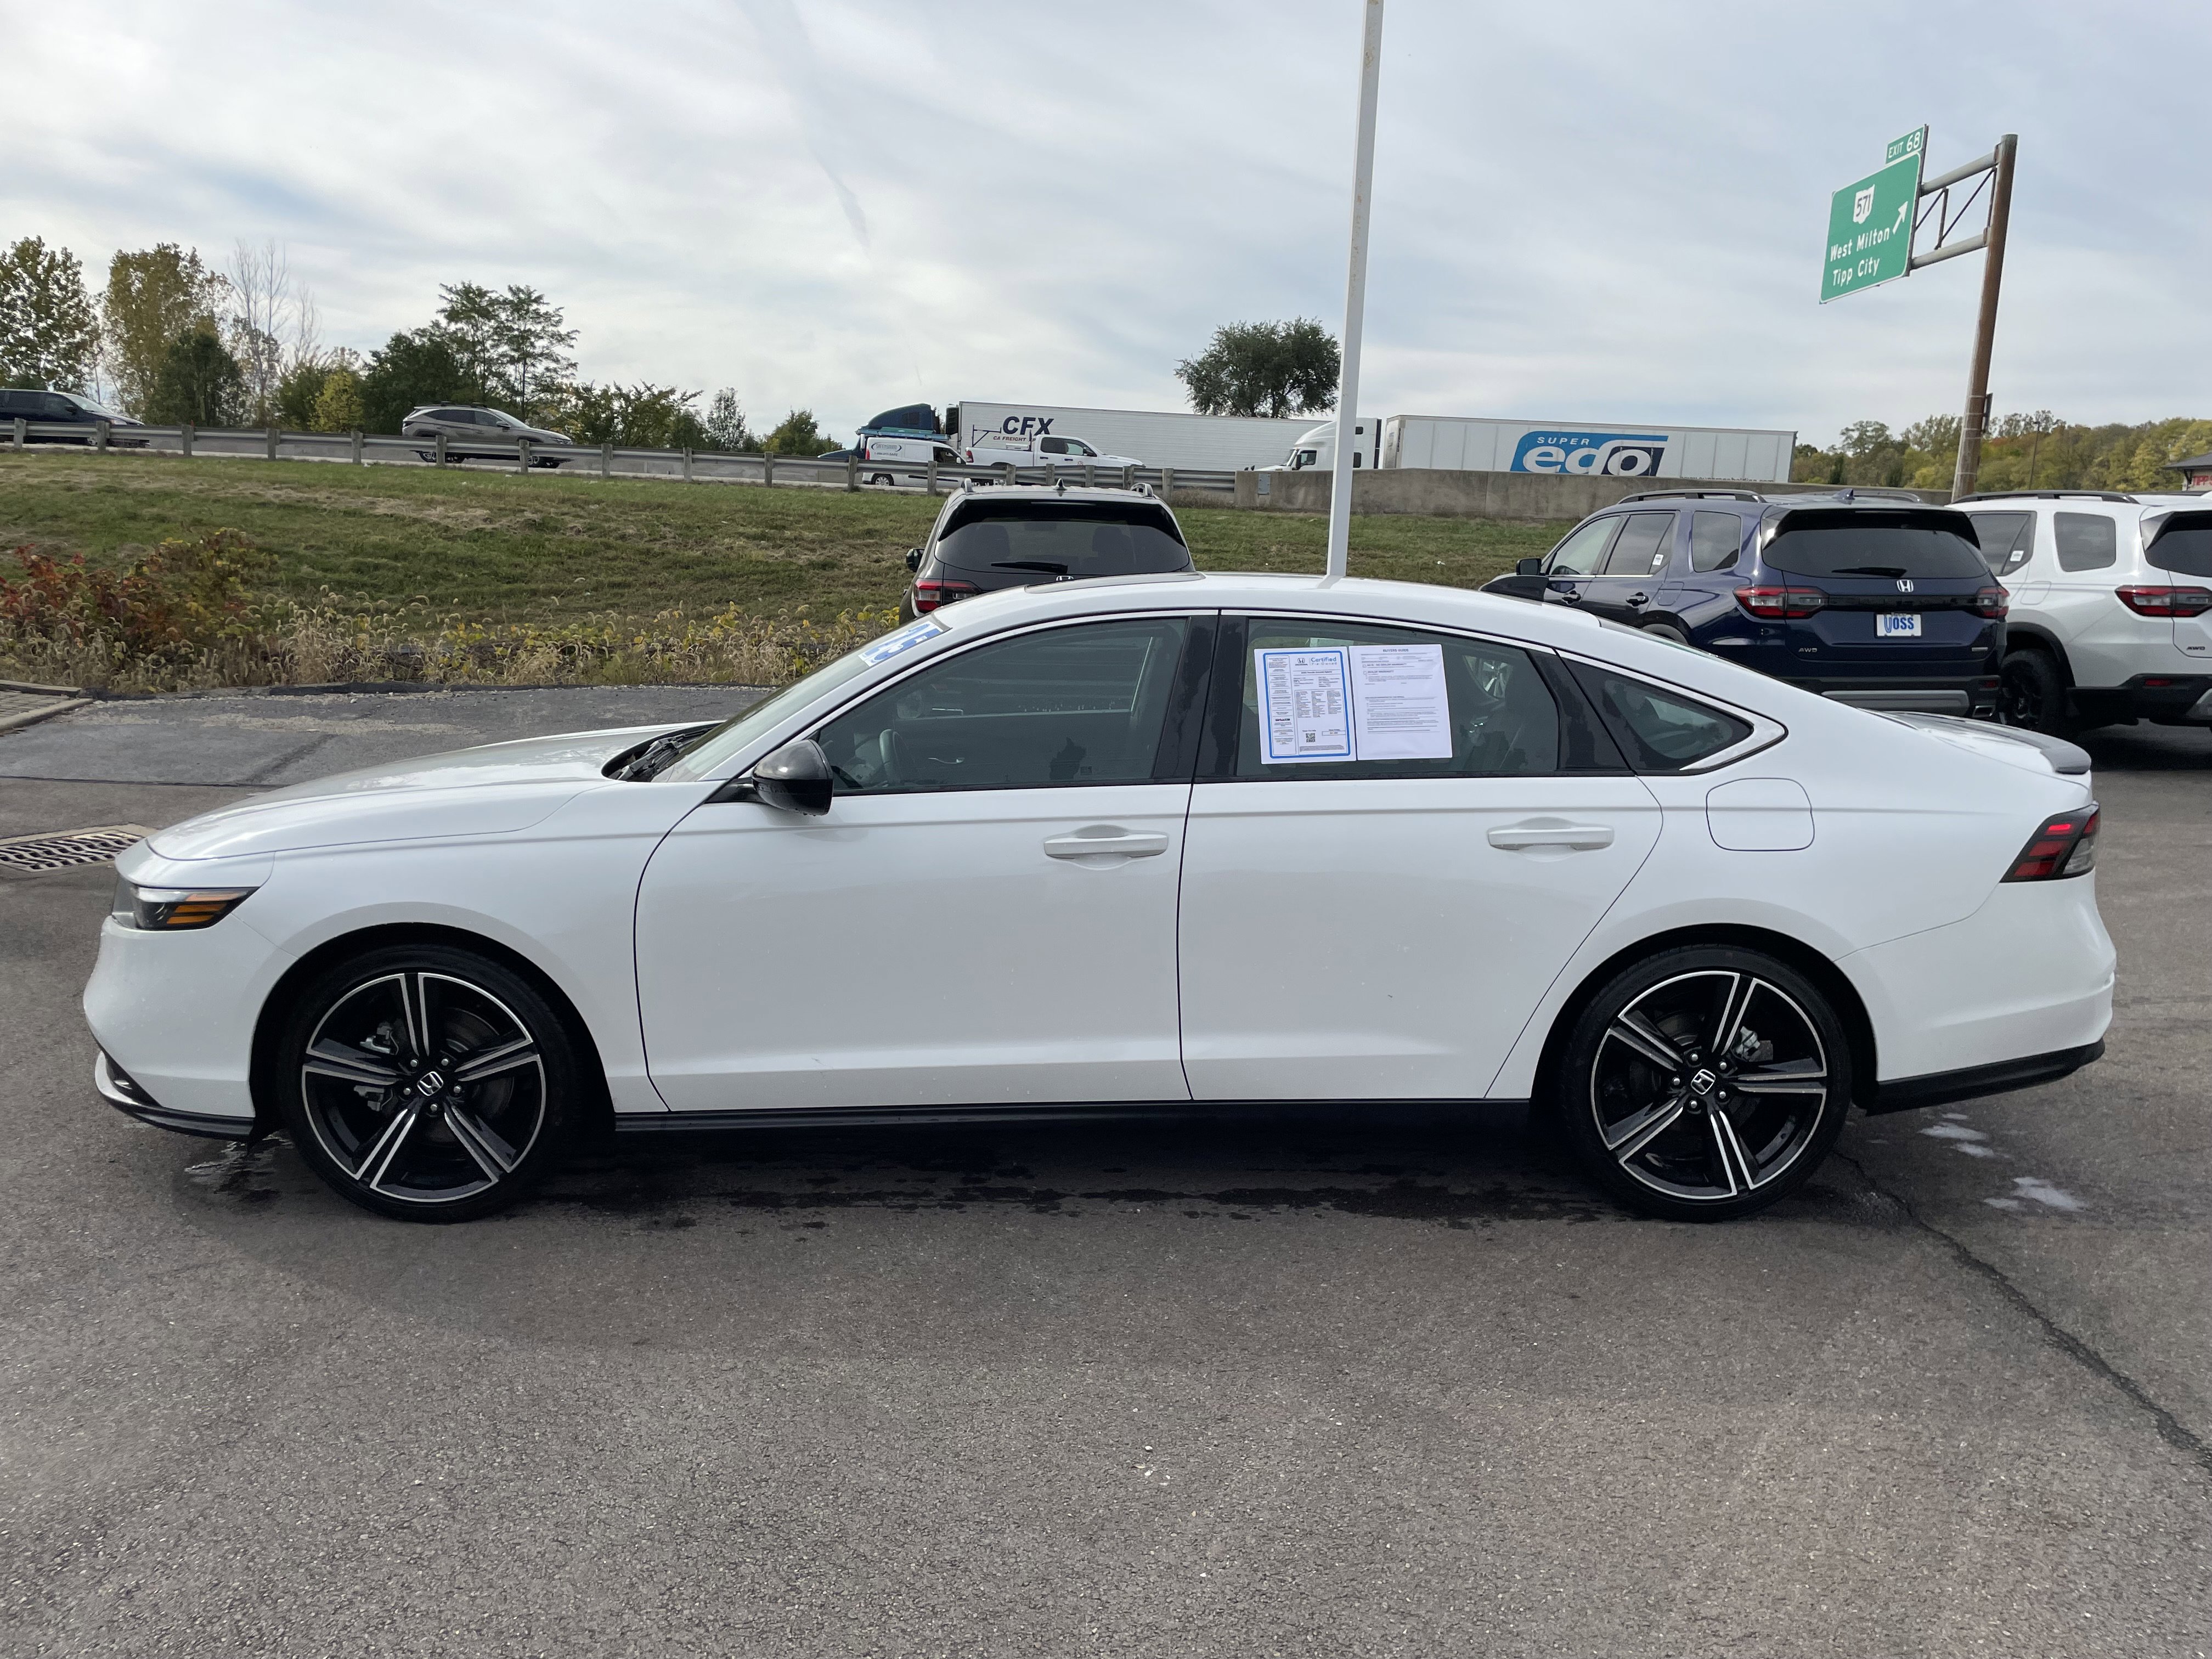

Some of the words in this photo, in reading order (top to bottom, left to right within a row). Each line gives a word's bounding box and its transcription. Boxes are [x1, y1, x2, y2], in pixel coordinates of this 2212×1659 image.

[1888, 142, 1904, 159] EXIT
[1906, 131, 1921, 152] 68
[1856, 194, 1871, 217] 571
[1830, 239, 1853, 262] West
[1857, 228, 1890, 252] Milton
[1833, 268, 1853, 287] Tipp
[1858, 257, 1880, 277] City
[1002, 416, 1054, 436] CFX
[1537, 437, 1590, 445] SUPER
